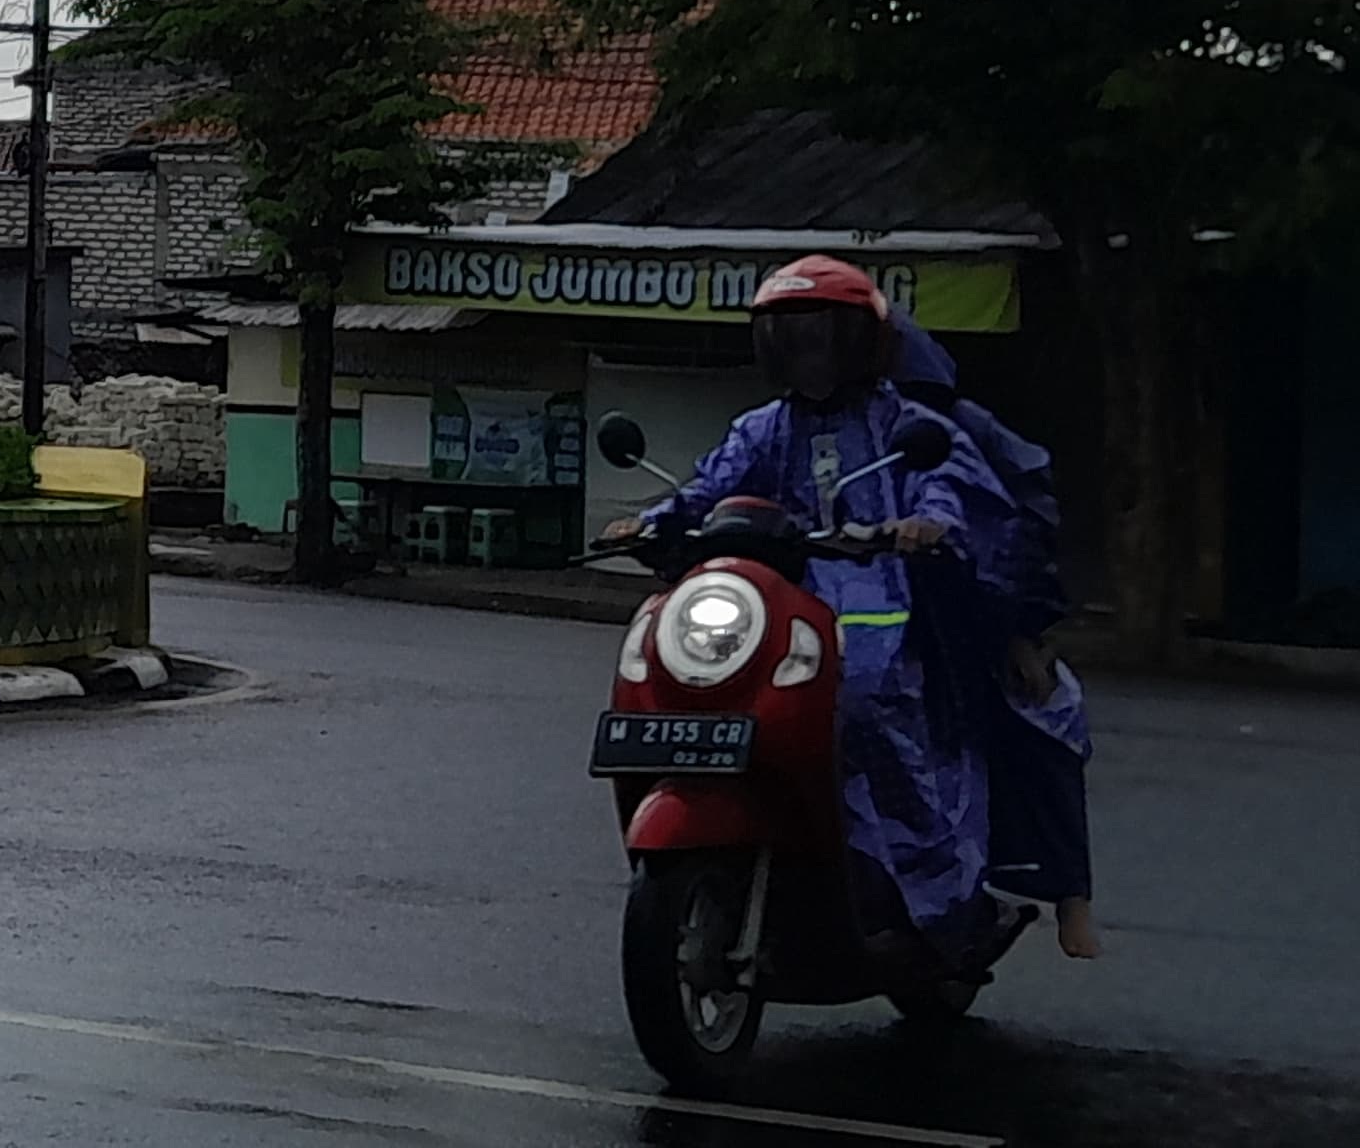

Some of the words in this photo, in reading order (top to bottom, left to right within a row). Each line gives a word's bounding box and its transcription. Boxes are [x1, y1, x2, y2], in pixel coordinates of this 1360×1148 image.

[387, 247, 522, 297] BAKSO
[530, 255, 697, 308] JUMBO
[642, 720, 701, 744] 2155
